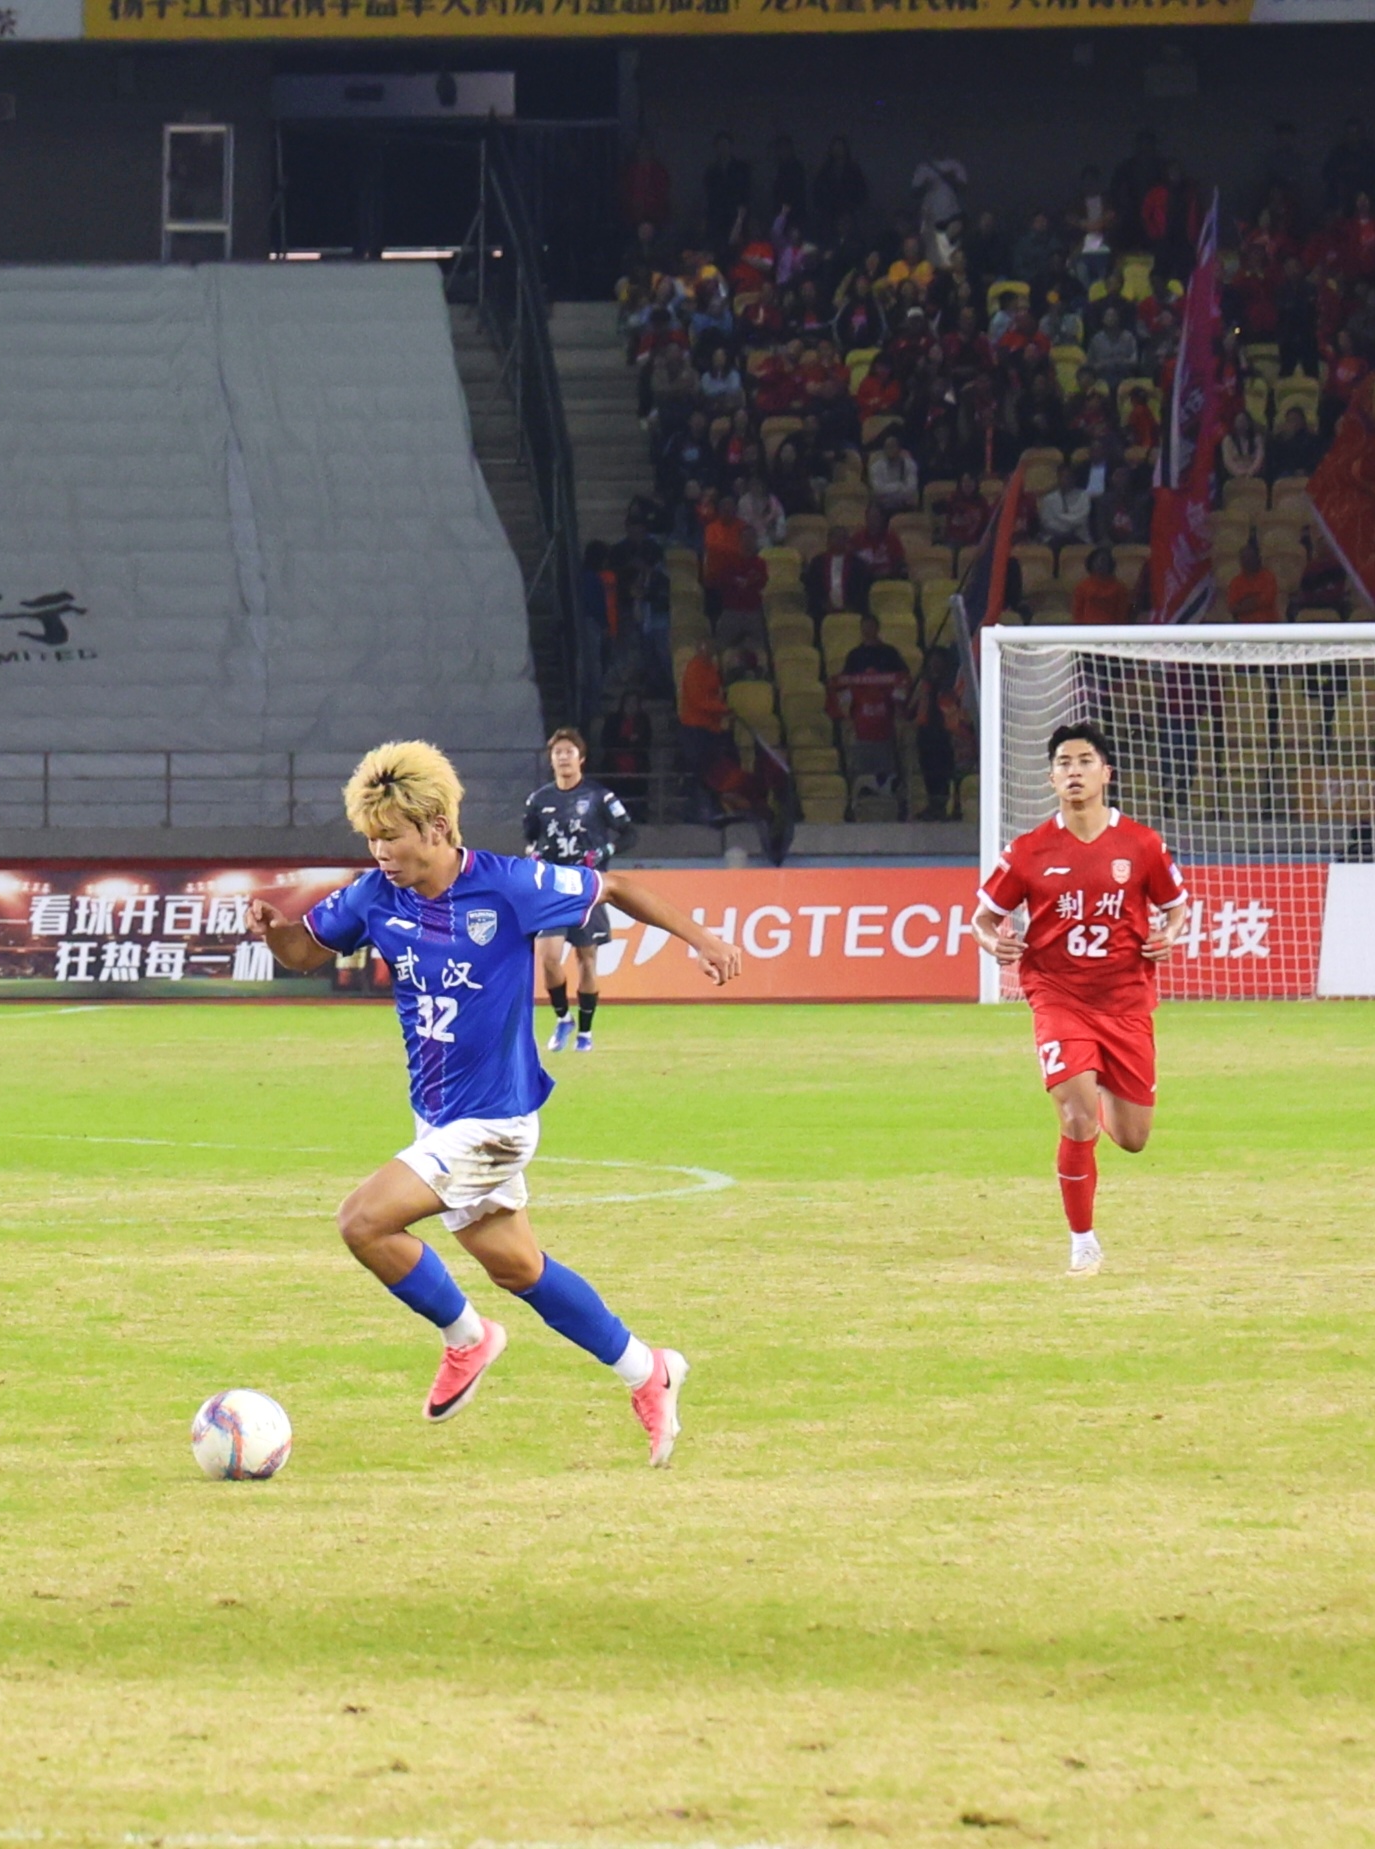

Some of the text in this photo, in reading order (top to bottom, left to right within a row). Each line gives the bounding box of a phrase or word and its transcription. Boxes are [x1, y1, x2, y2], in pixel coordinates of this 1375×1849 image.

[29, 894, 251, 935] 看球开百威
[1055, 888, 1125, 921] 荆州
[55, 940, 275, 982] 狂热每一杯
[1067, 924, 1110, 958] 62
[394, 946, 483, 992] 武汉
[415, 994, 459, 1043] 32
